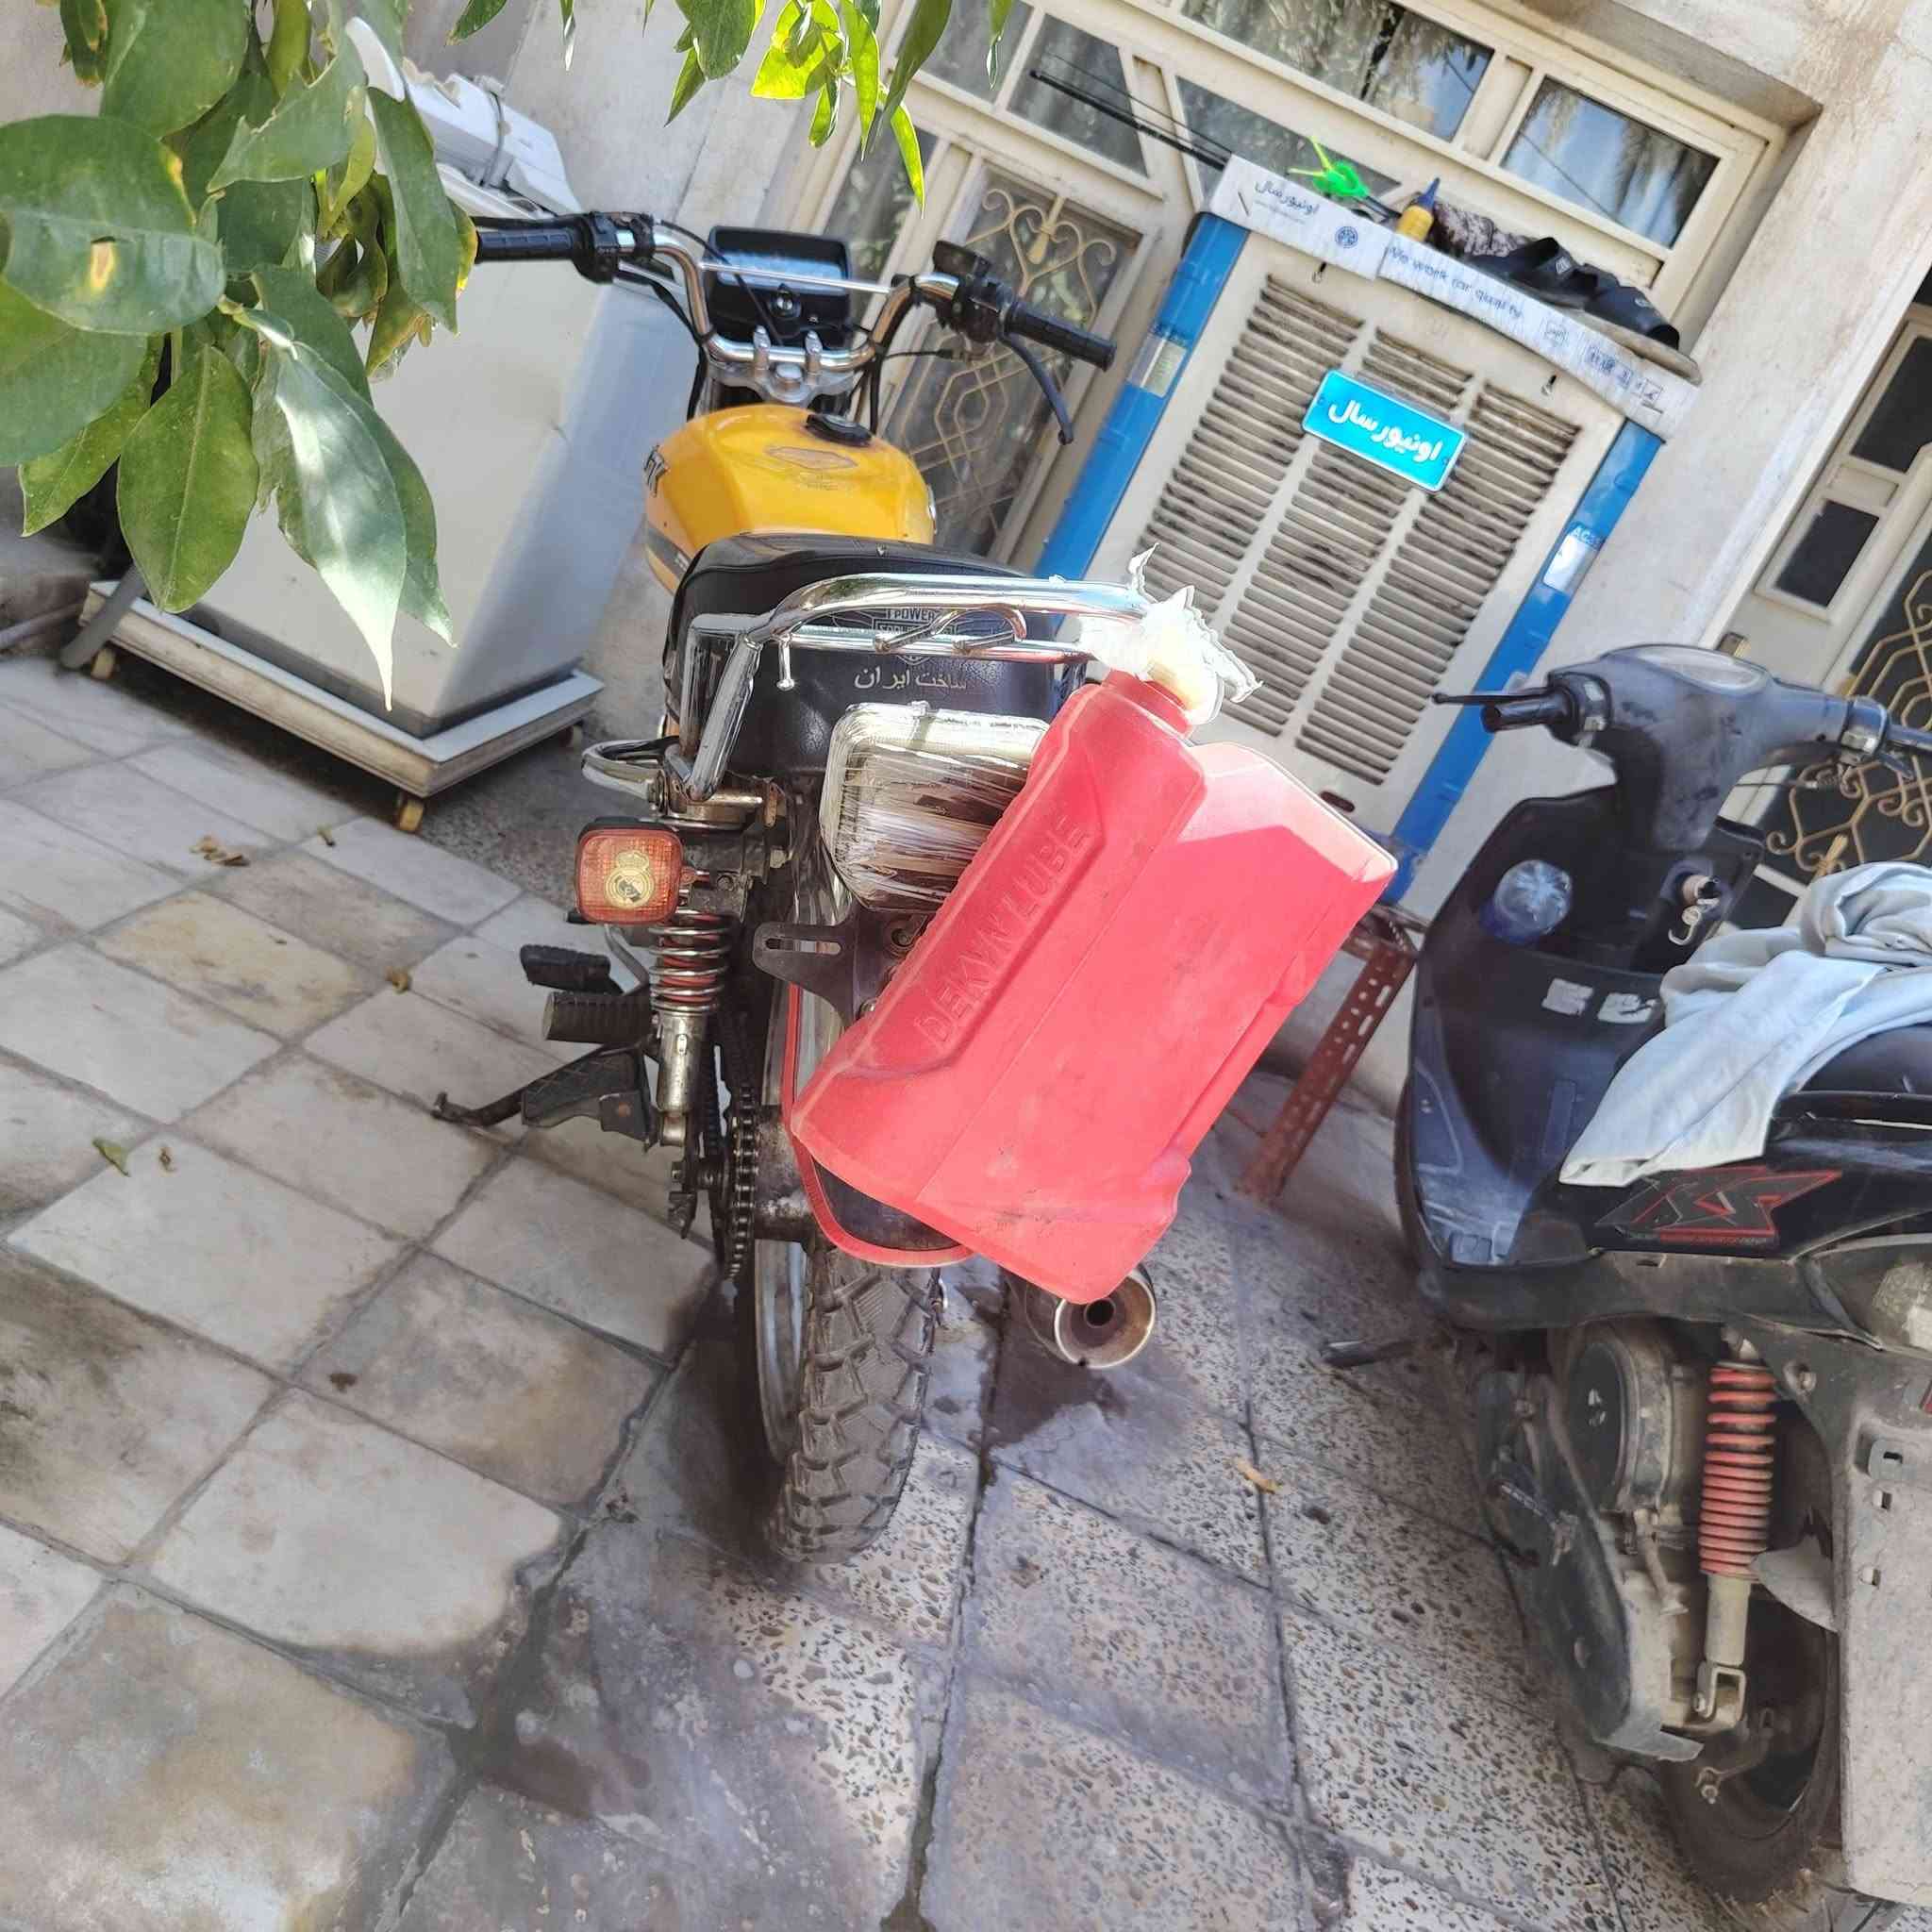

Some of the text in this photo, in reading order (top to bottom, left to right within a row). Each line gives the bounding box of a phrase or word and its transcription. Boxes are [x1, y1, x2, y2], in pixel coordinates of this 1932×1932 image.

[1327, 399, 1444, 463] اونیورسال
[854, 665, 967, 690] ساخت ایران
[1002, 814, 1087, 920] LUBE
